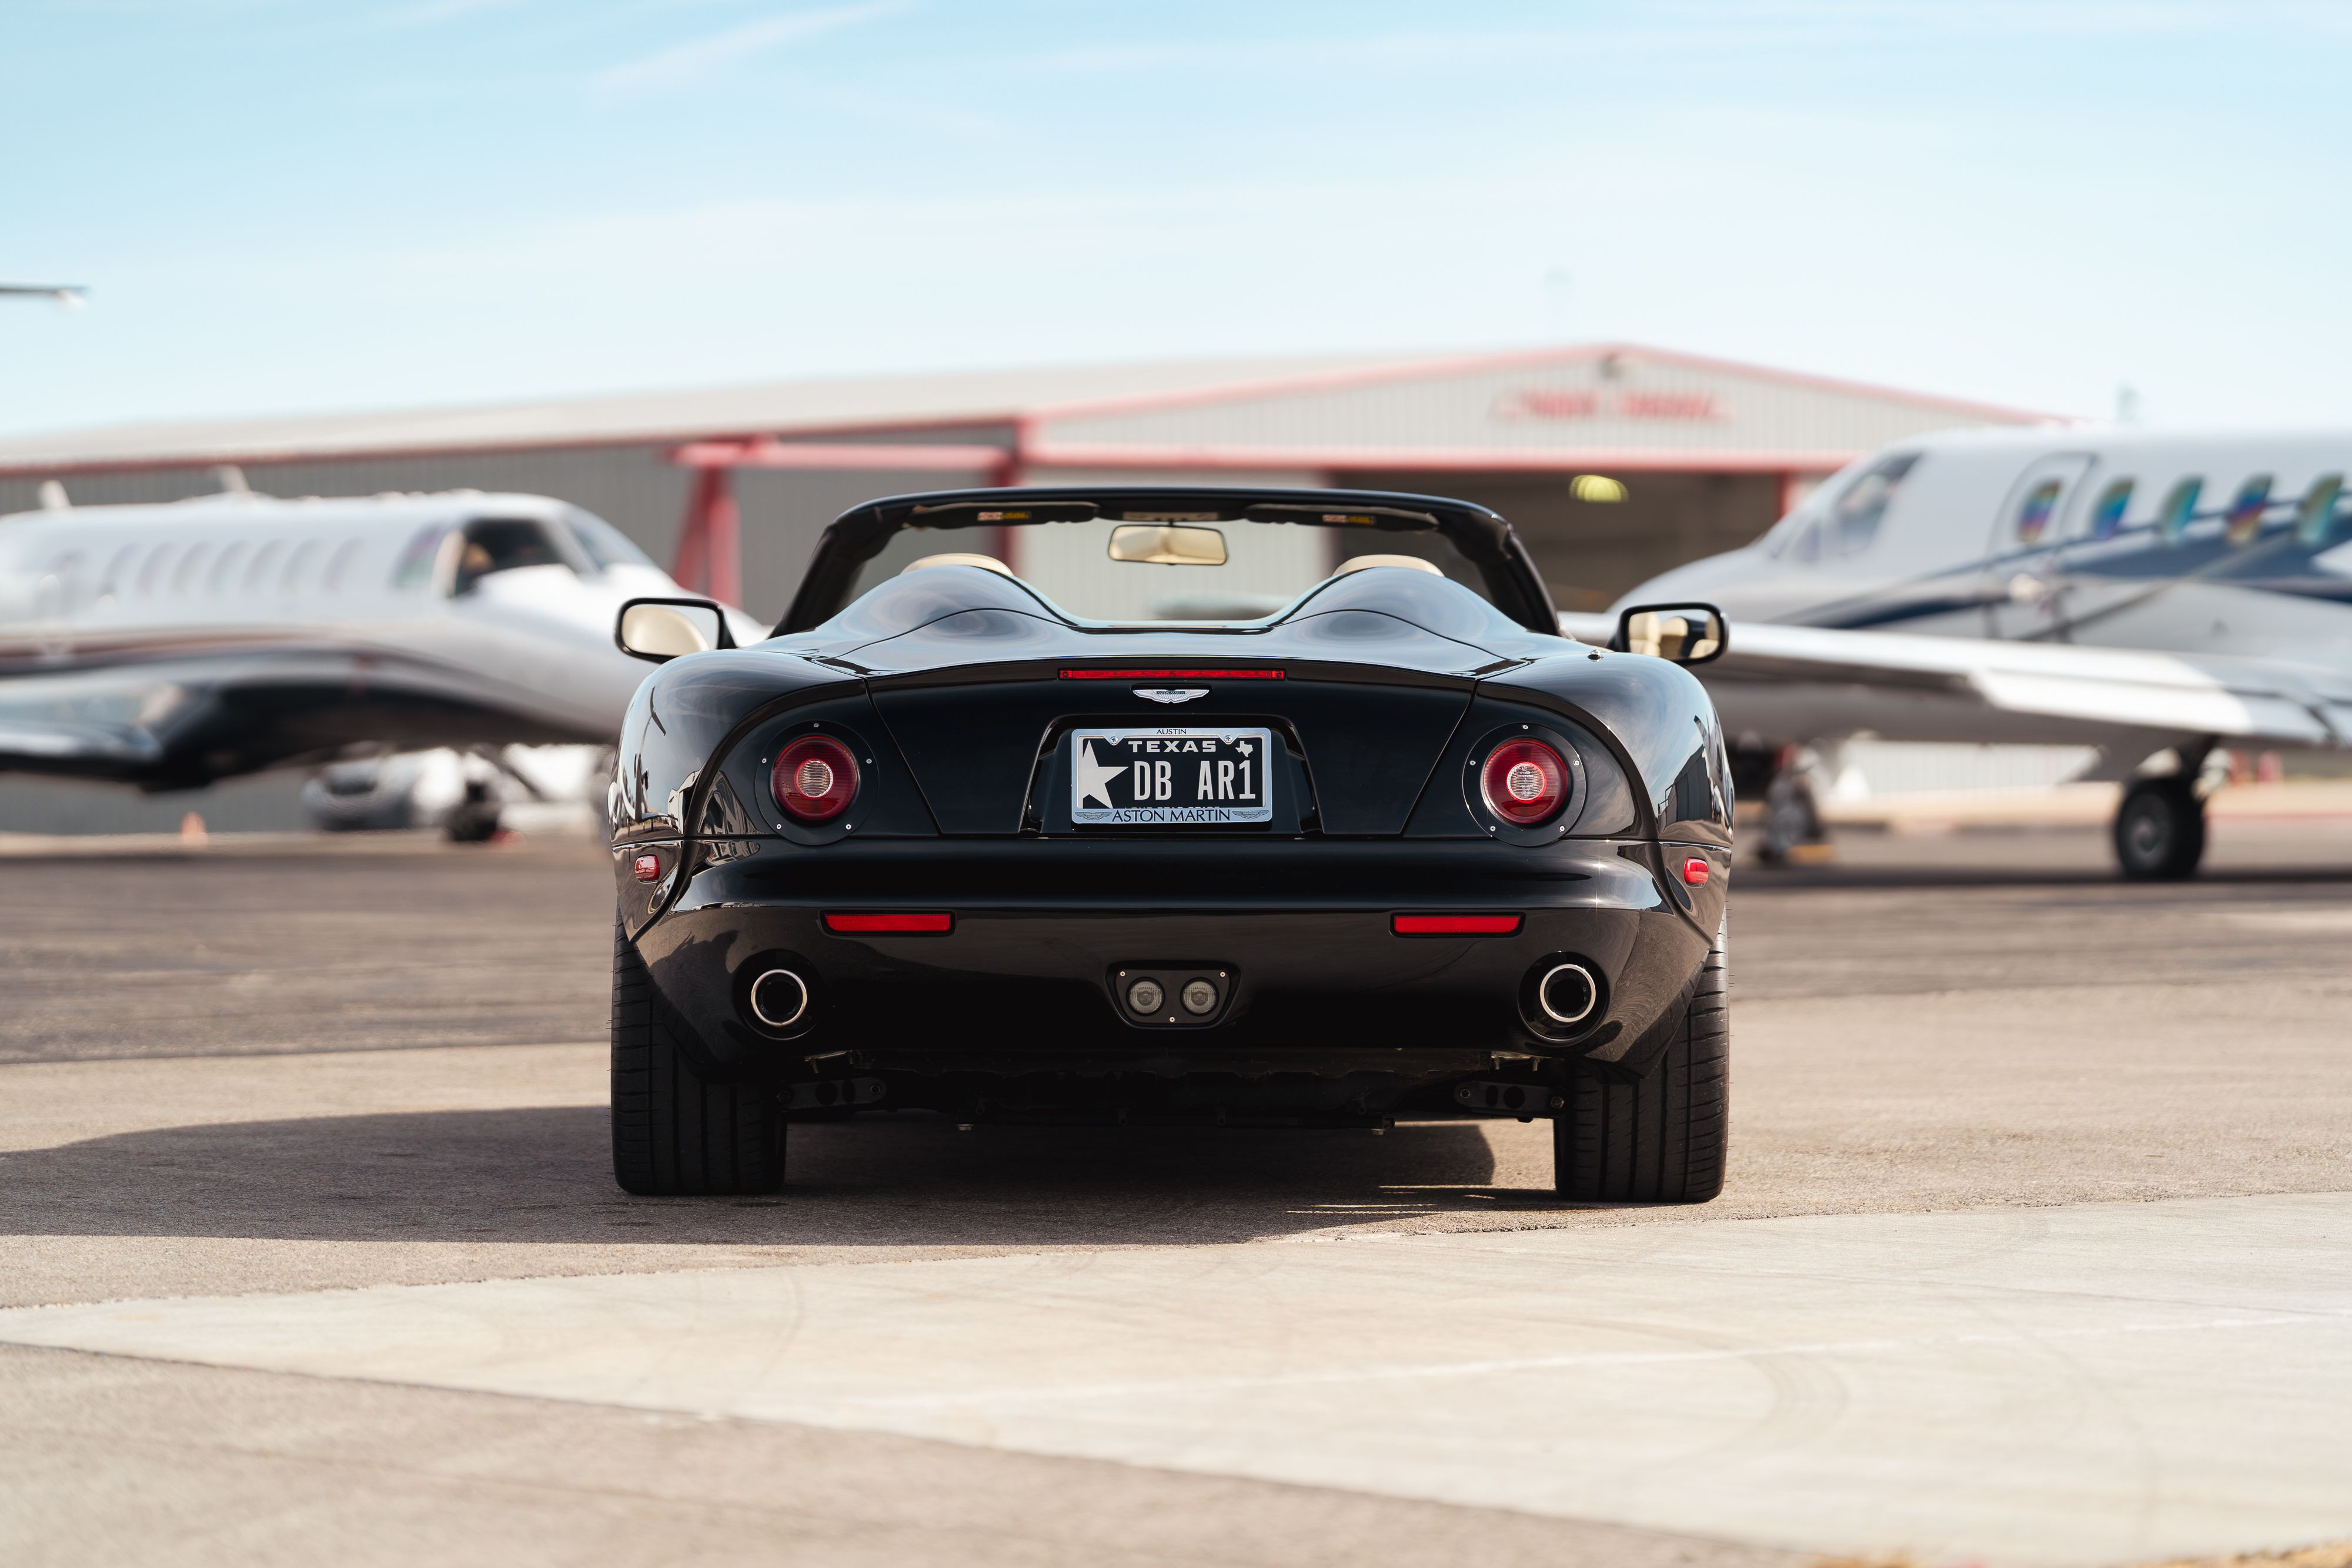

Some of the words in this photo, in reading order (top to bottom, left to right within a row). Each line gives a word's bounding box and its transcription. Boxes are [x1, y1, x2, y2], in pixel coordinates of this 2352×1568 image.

[1128, 740, 1217, 753] TEXAS
[1134, 761, 1172, 800] DB
[1197, 760, 1256, 800] AR1
[1112, 810, 1165, 822] ASTON
[1170, 809, 1230, 822] MARTIN
